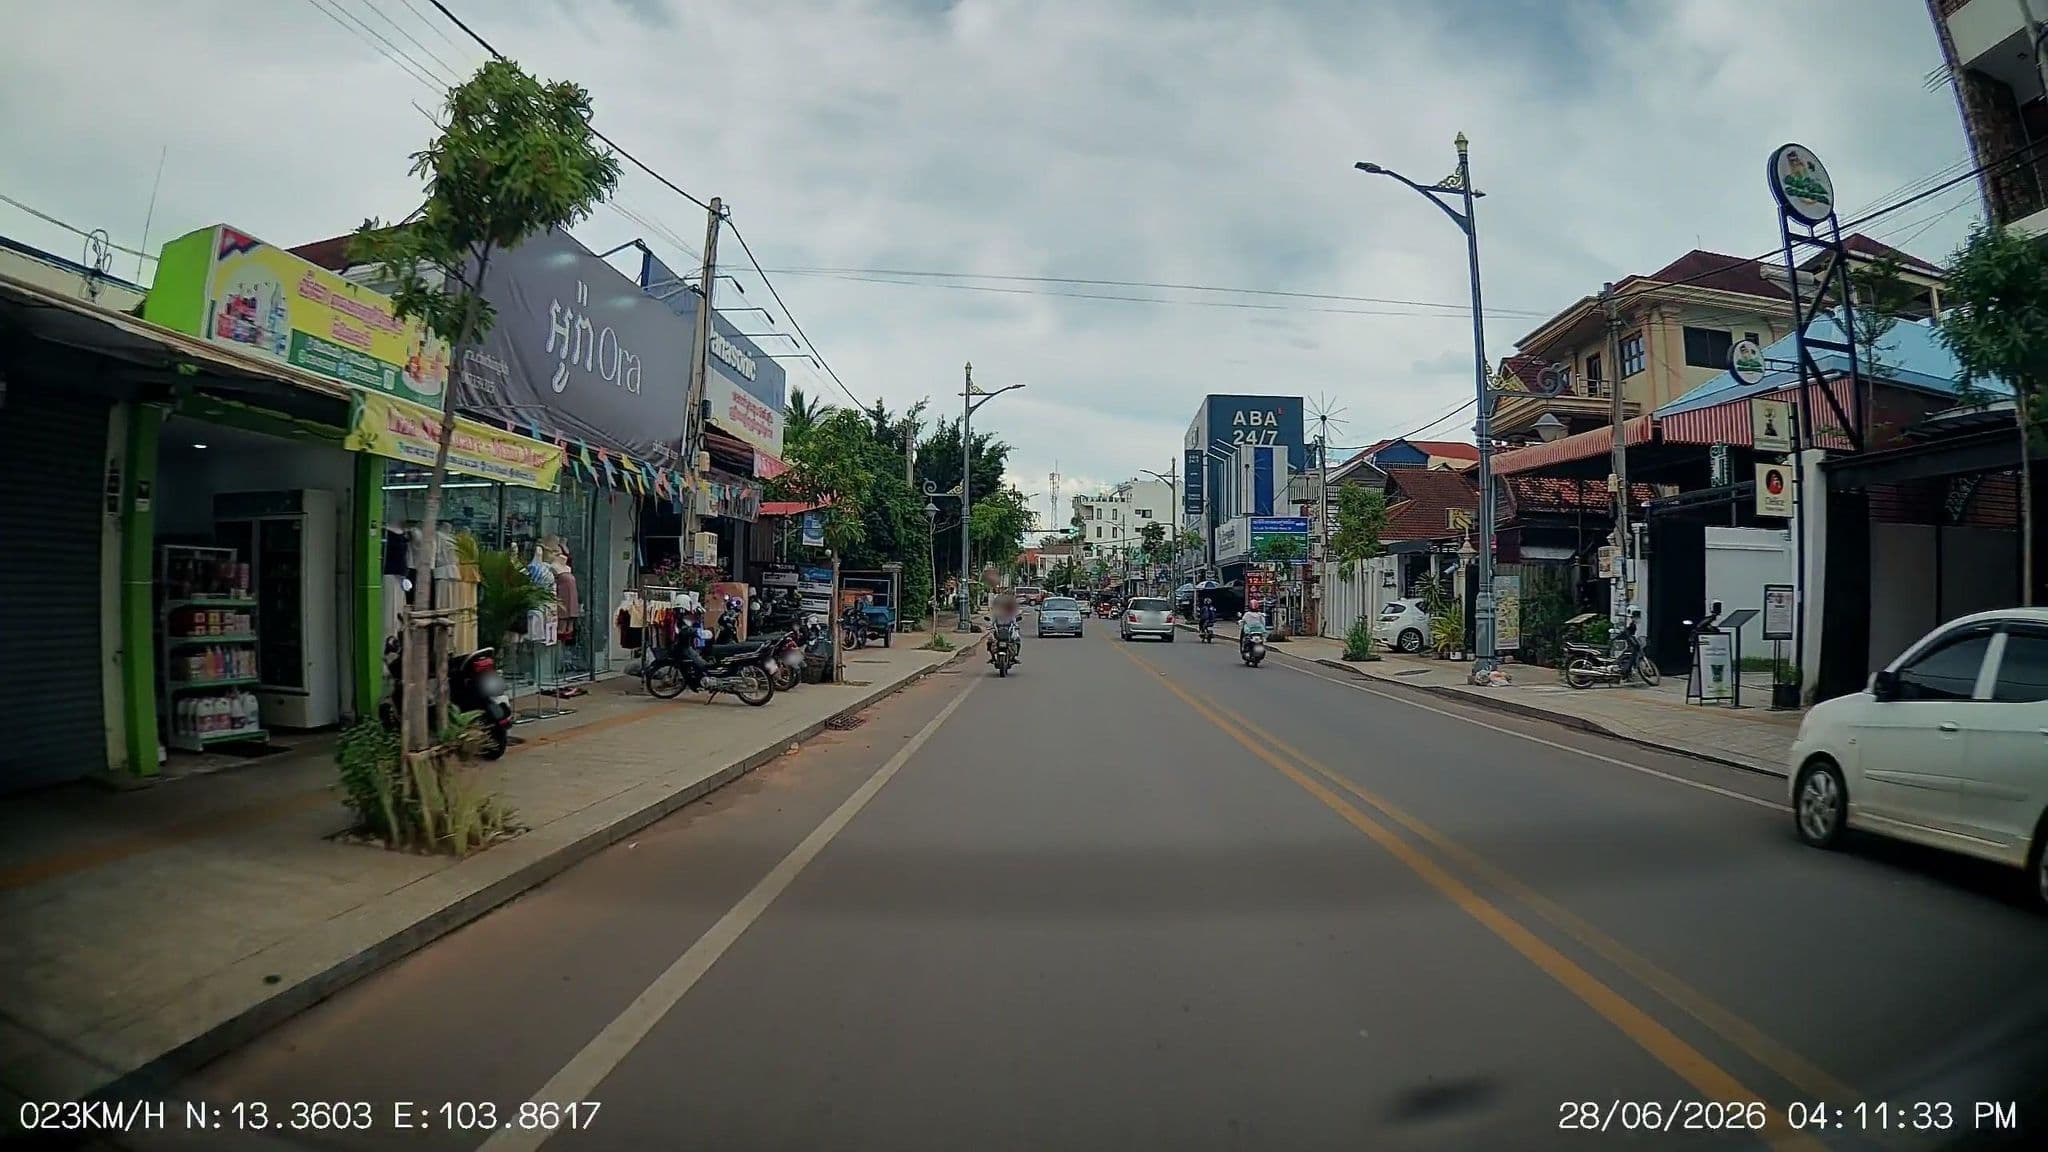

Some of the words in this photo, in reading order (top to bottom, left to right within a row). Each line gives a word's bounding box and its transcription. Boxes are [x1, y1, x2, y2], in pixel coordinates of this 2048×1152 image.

[599, 326, 641, 395] Ora
[710, 319, 757, 381] anasonic
[1232, 410, 1278, 426] ABA
[1233, 429, 1278, 445] 24/7
